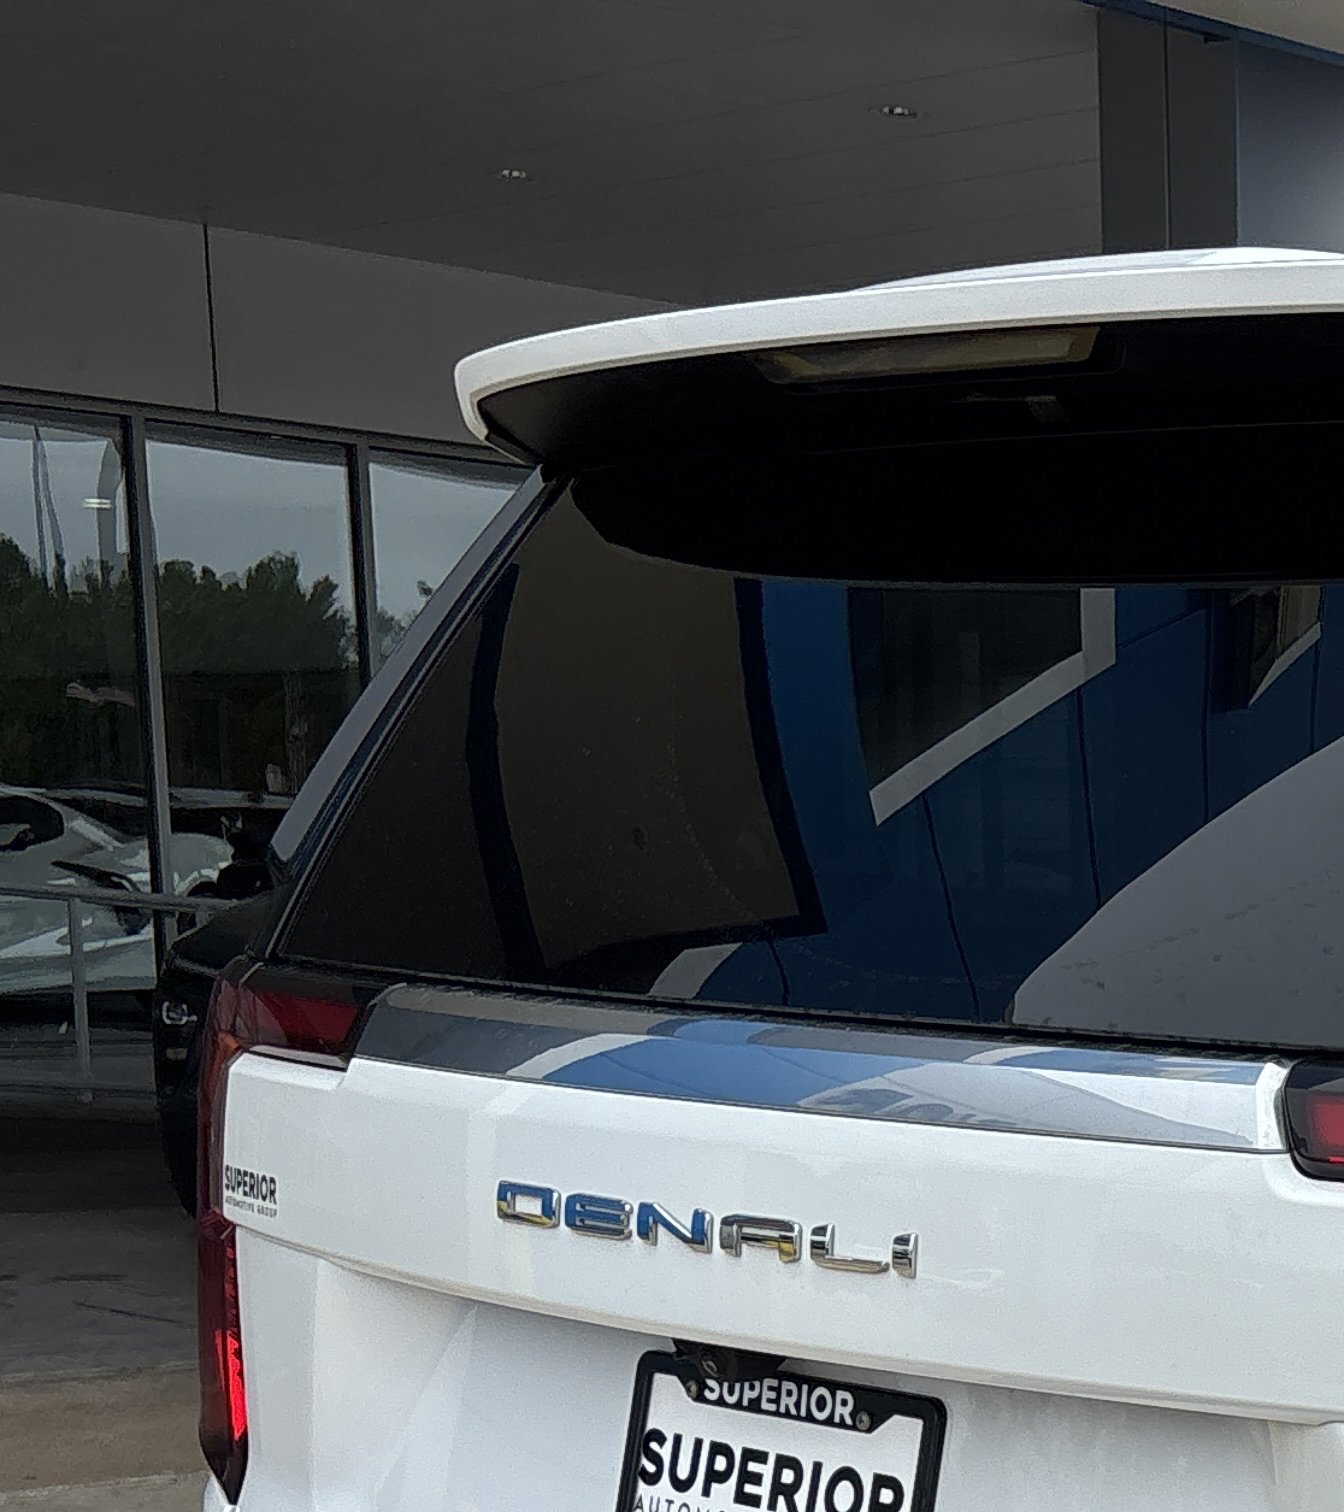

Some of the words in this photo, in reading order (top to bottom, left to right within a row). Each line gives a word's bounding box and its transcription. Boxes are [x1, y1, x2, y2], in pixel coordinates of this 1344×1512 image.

[225, 1164, 278, 1206] SUPERIOR
[496, 1179, 919, 1280] DENALI
[703, 1377, 857, 1427] SUPERIOR
